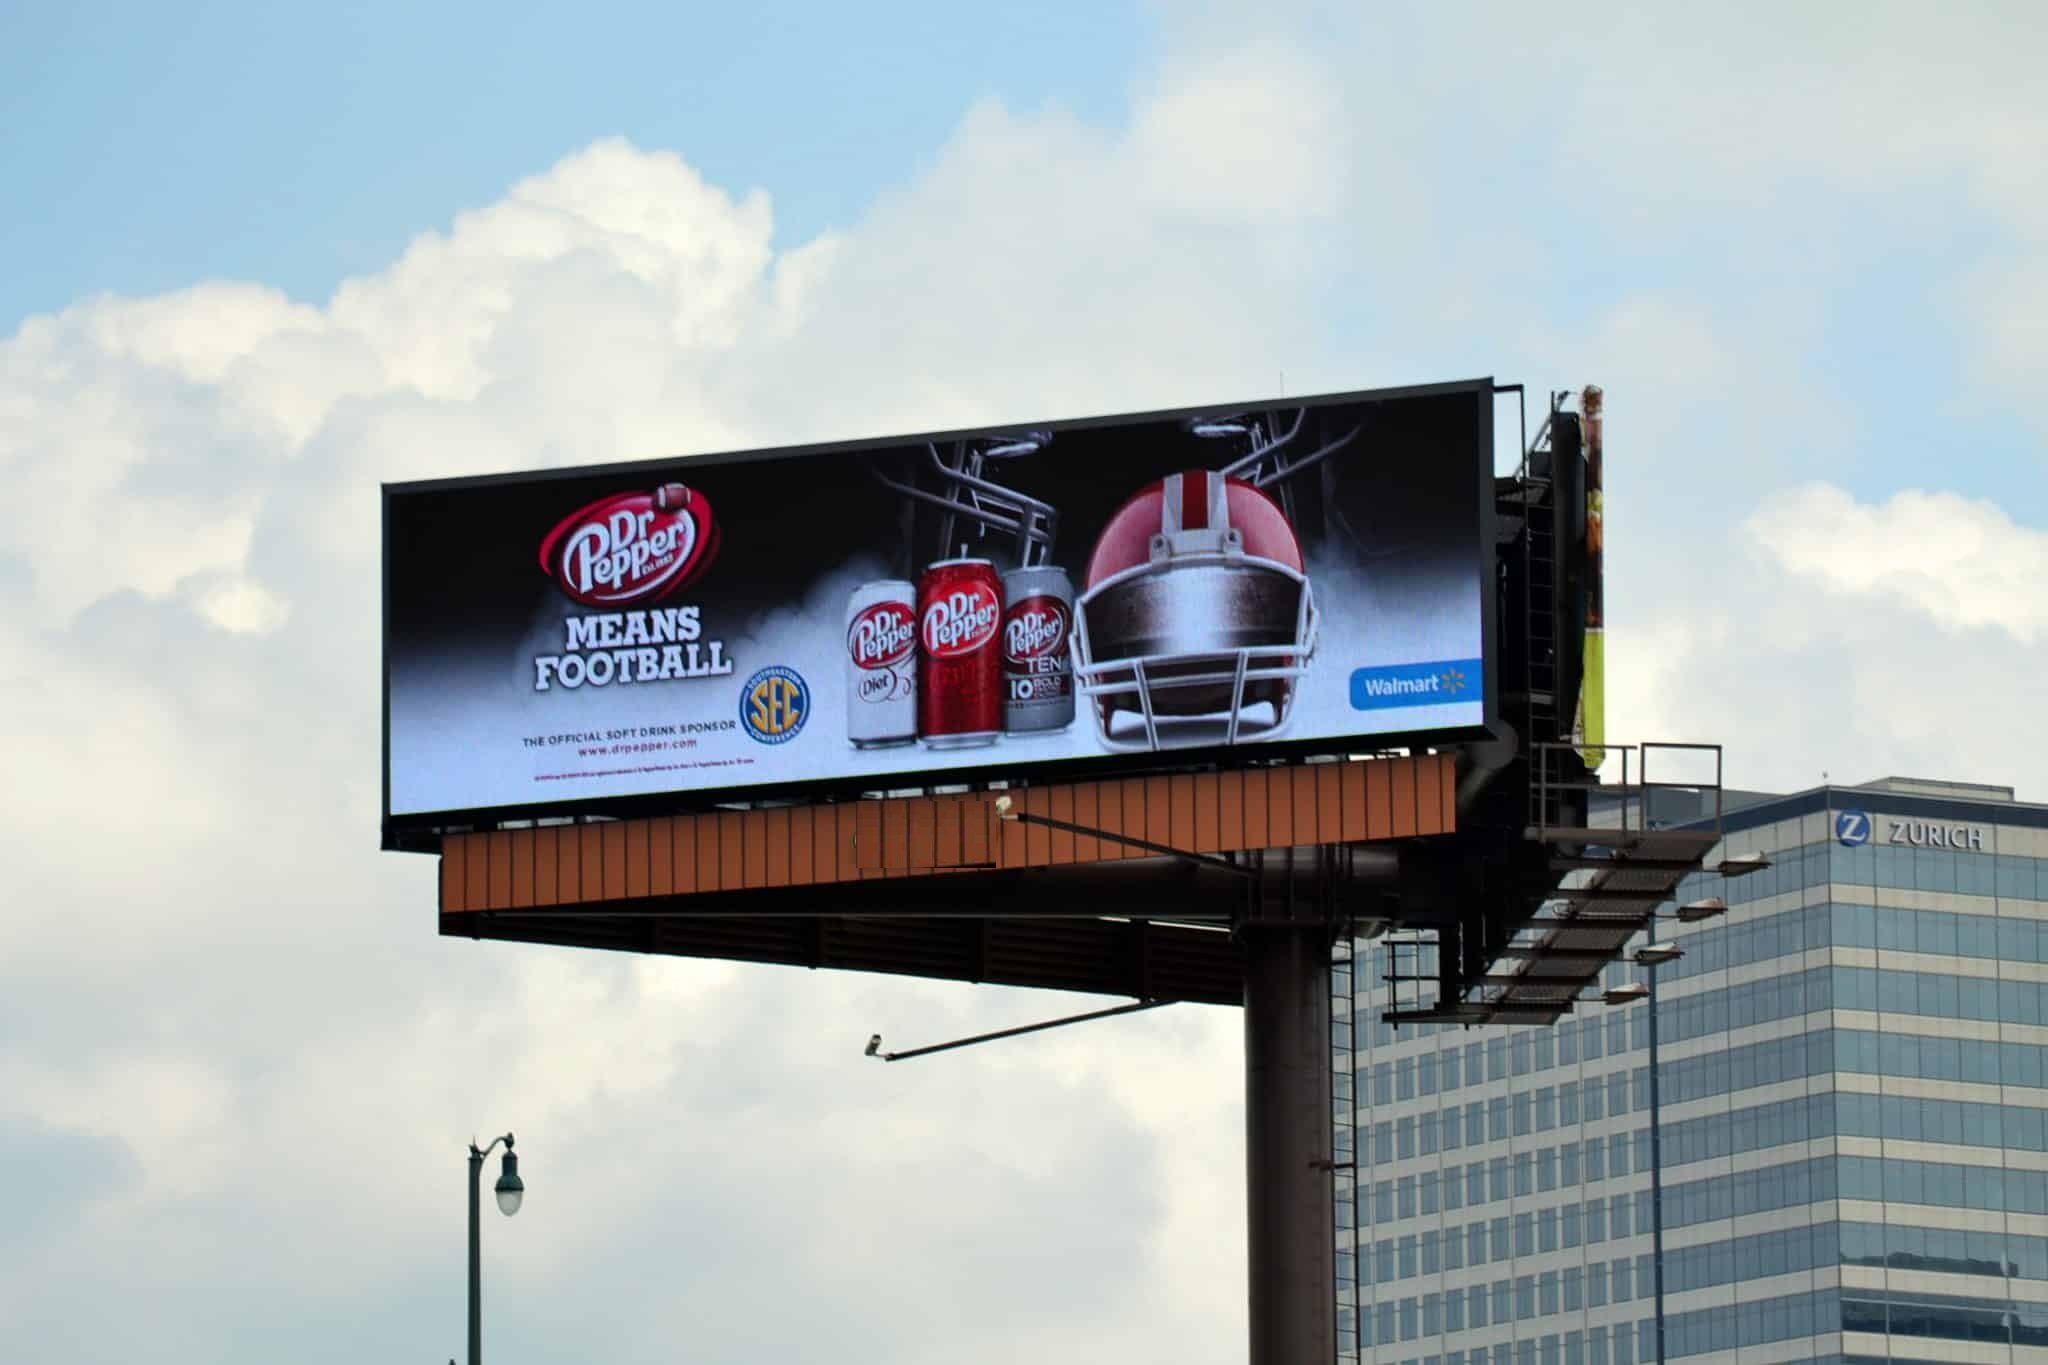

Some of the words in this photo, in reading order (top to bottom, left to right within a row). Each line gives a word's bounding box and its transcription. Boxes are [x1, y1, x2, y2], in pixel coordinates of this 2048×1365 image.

[608, 509, 654, 554] Dr
[563, 520, 684, 593] Pepper
[949, 592, 980, 618] Dr
[566, 606, 701, 651] MEANS
[876, 610, 902, 632] Dr
[930, 602, 996, 650] Pepper
[1023, 612, 1046, 634] Dr
[859, 619, 916, 662] Pepper
[1008, 620, 1058, 656] Pepper
[535, 641, 733, 691] FOOTBALL
[1026, 656, 1061, 673] TEN
[863, 674, 889, 695] Diet
[1011, 679, 1033, 700] 10
[1366, 674, 1439, 697] Walmart
[750, 676, 801, 735] SEC
[523, 736, 545, 748] THE
[547, 730, 602, 746] OFFICIAL
[606, 727, 637, 741] SOFT
[640, 724, 676, 737] DRINK
[680, 720, 736, 735] SPONSOR
[578, 738, 698, 757] www.drpepper.com
[1890, 822, 1985, 850] ZURICH
